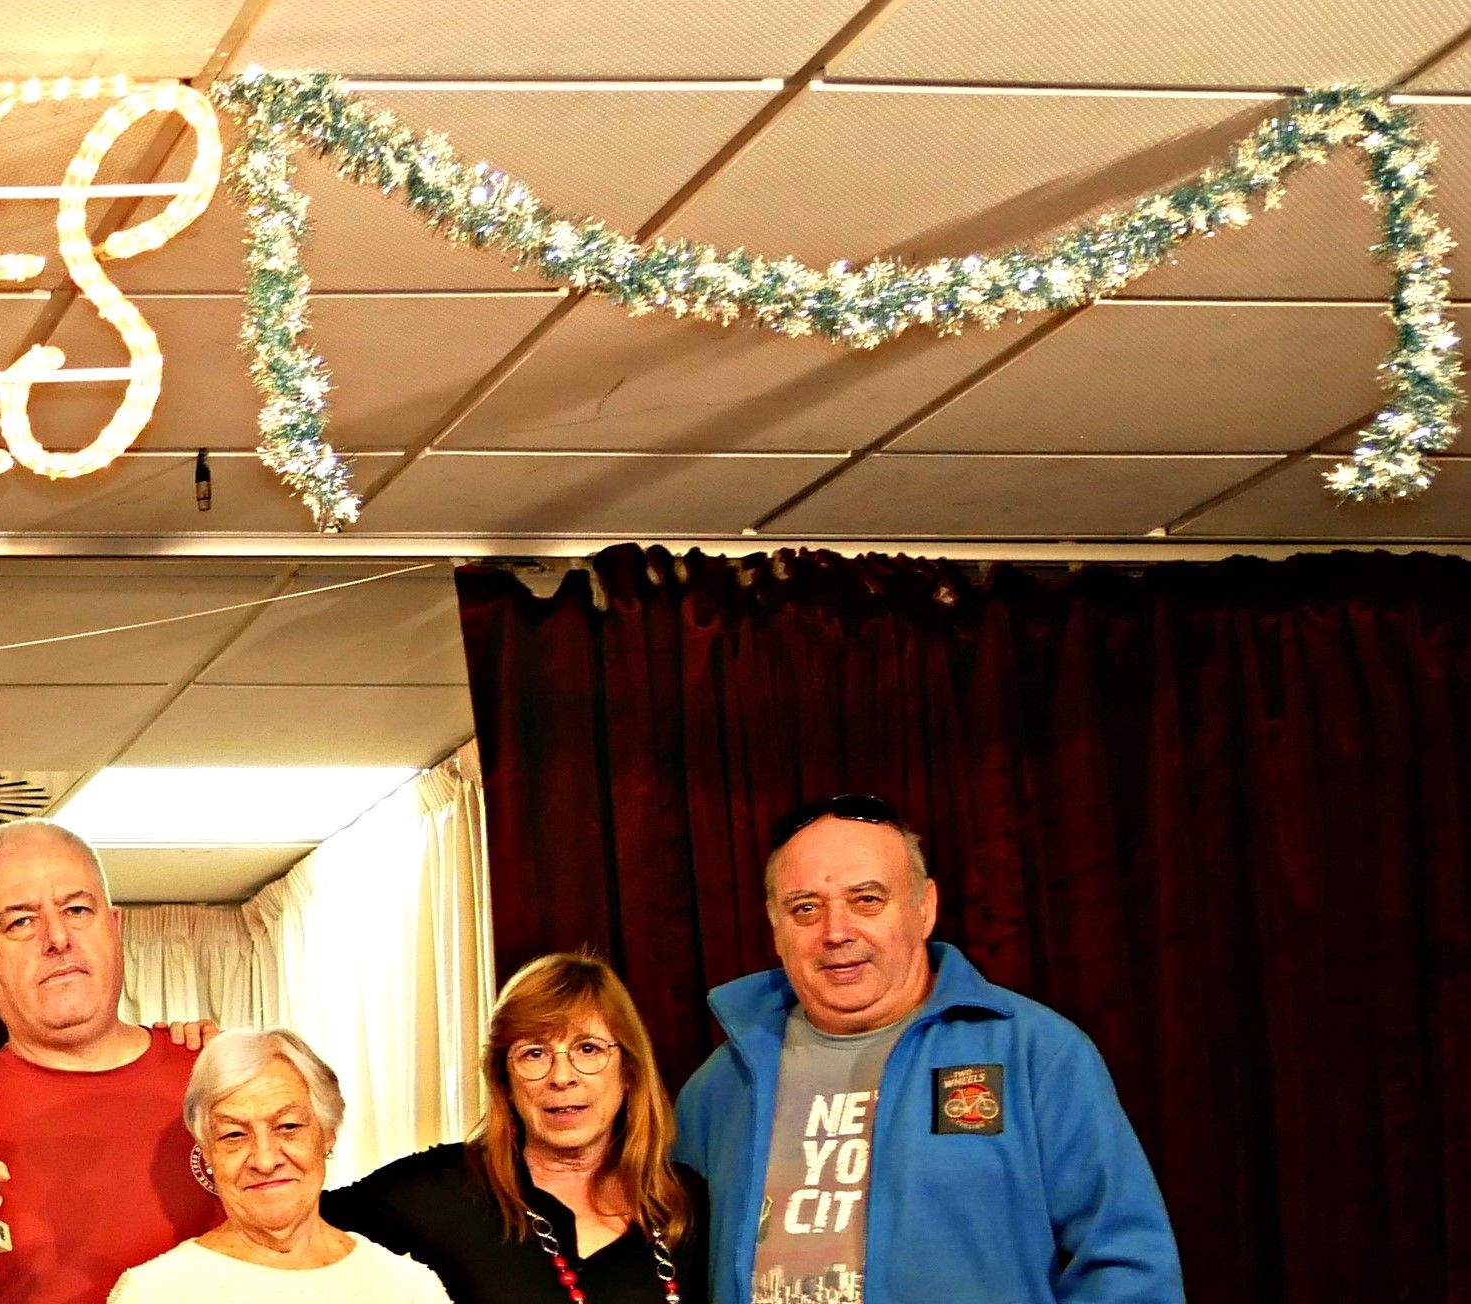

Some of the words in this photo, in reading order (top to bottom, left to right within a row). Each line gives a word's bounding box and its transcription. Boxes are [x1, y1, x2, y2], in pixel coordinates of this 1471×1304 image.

[805, 1090, 878, 1137] NE
[802, 1138, 870, 1186] YO
[784, 1189, 863, 1235] CIT
